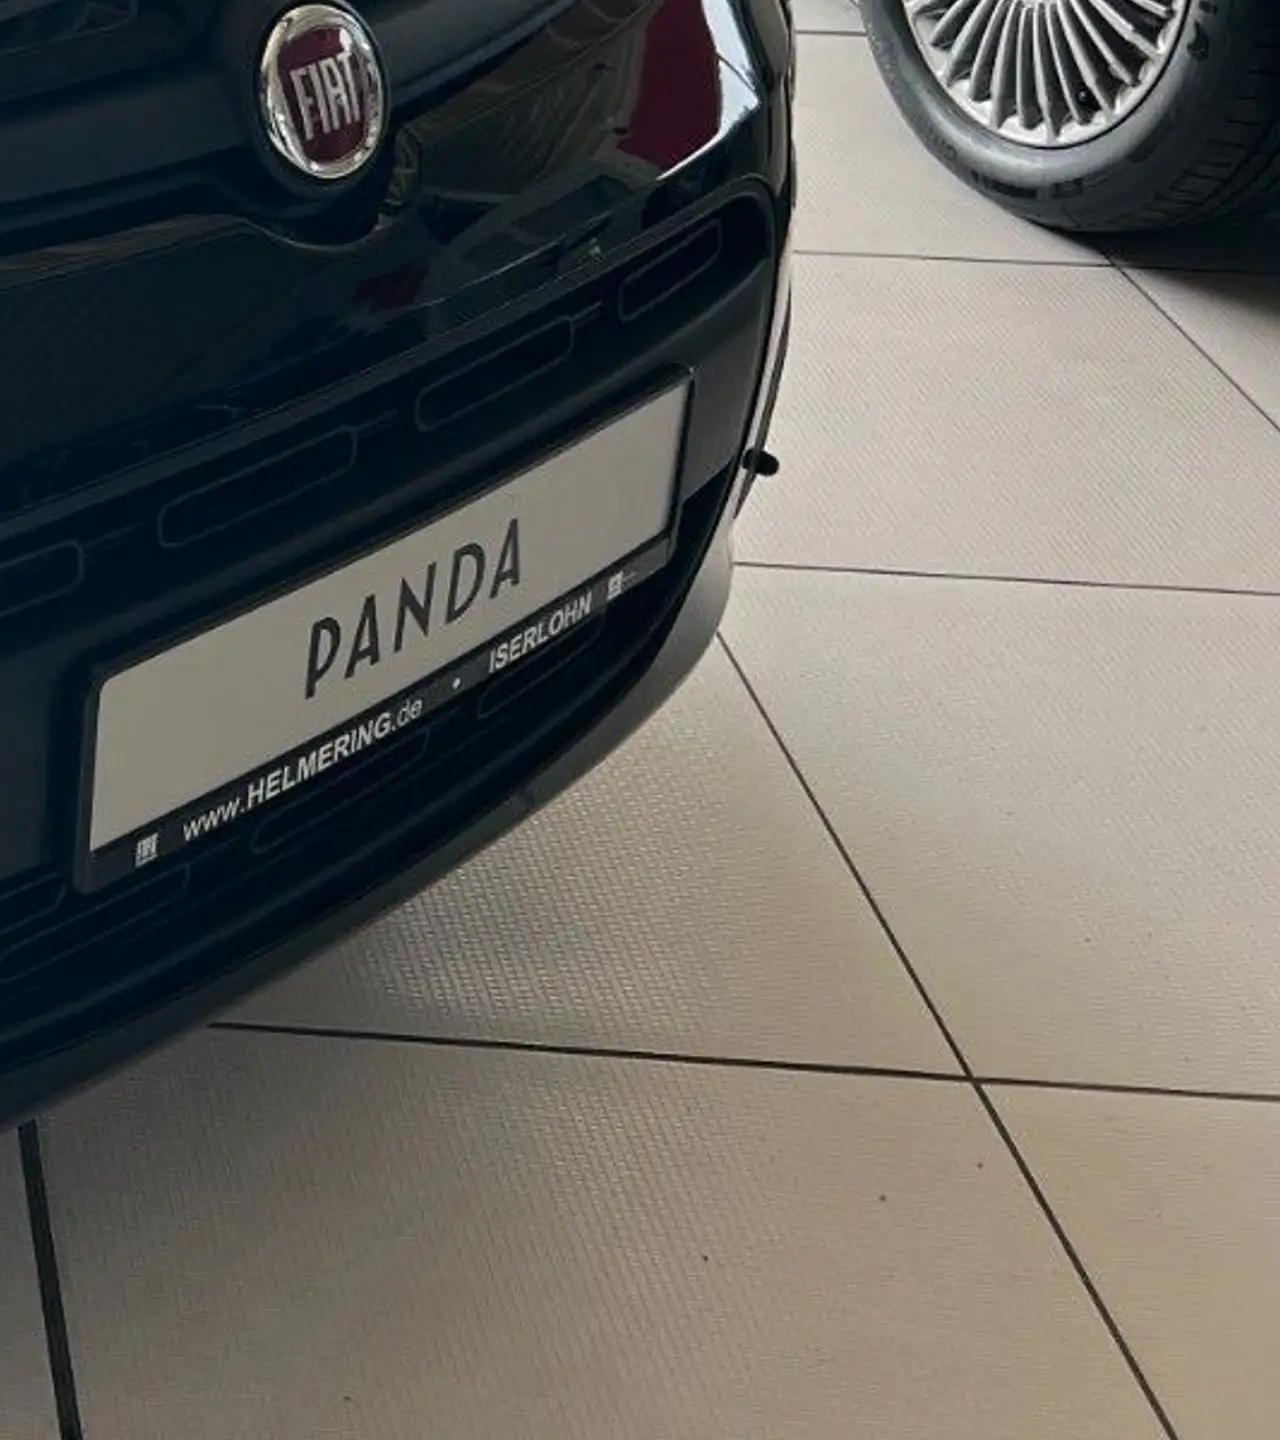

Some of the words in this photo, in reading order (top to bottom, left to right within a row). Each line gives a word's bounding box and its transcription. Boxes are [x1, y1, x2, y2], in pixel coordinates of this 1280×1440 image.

[290, 53, 361, 141] FIAT
[303, 517, 522, 700] PANDA
[182, 698, 423, 843] www.HELMERING.de
[488, 591, 593, 674] ISERLOHN
